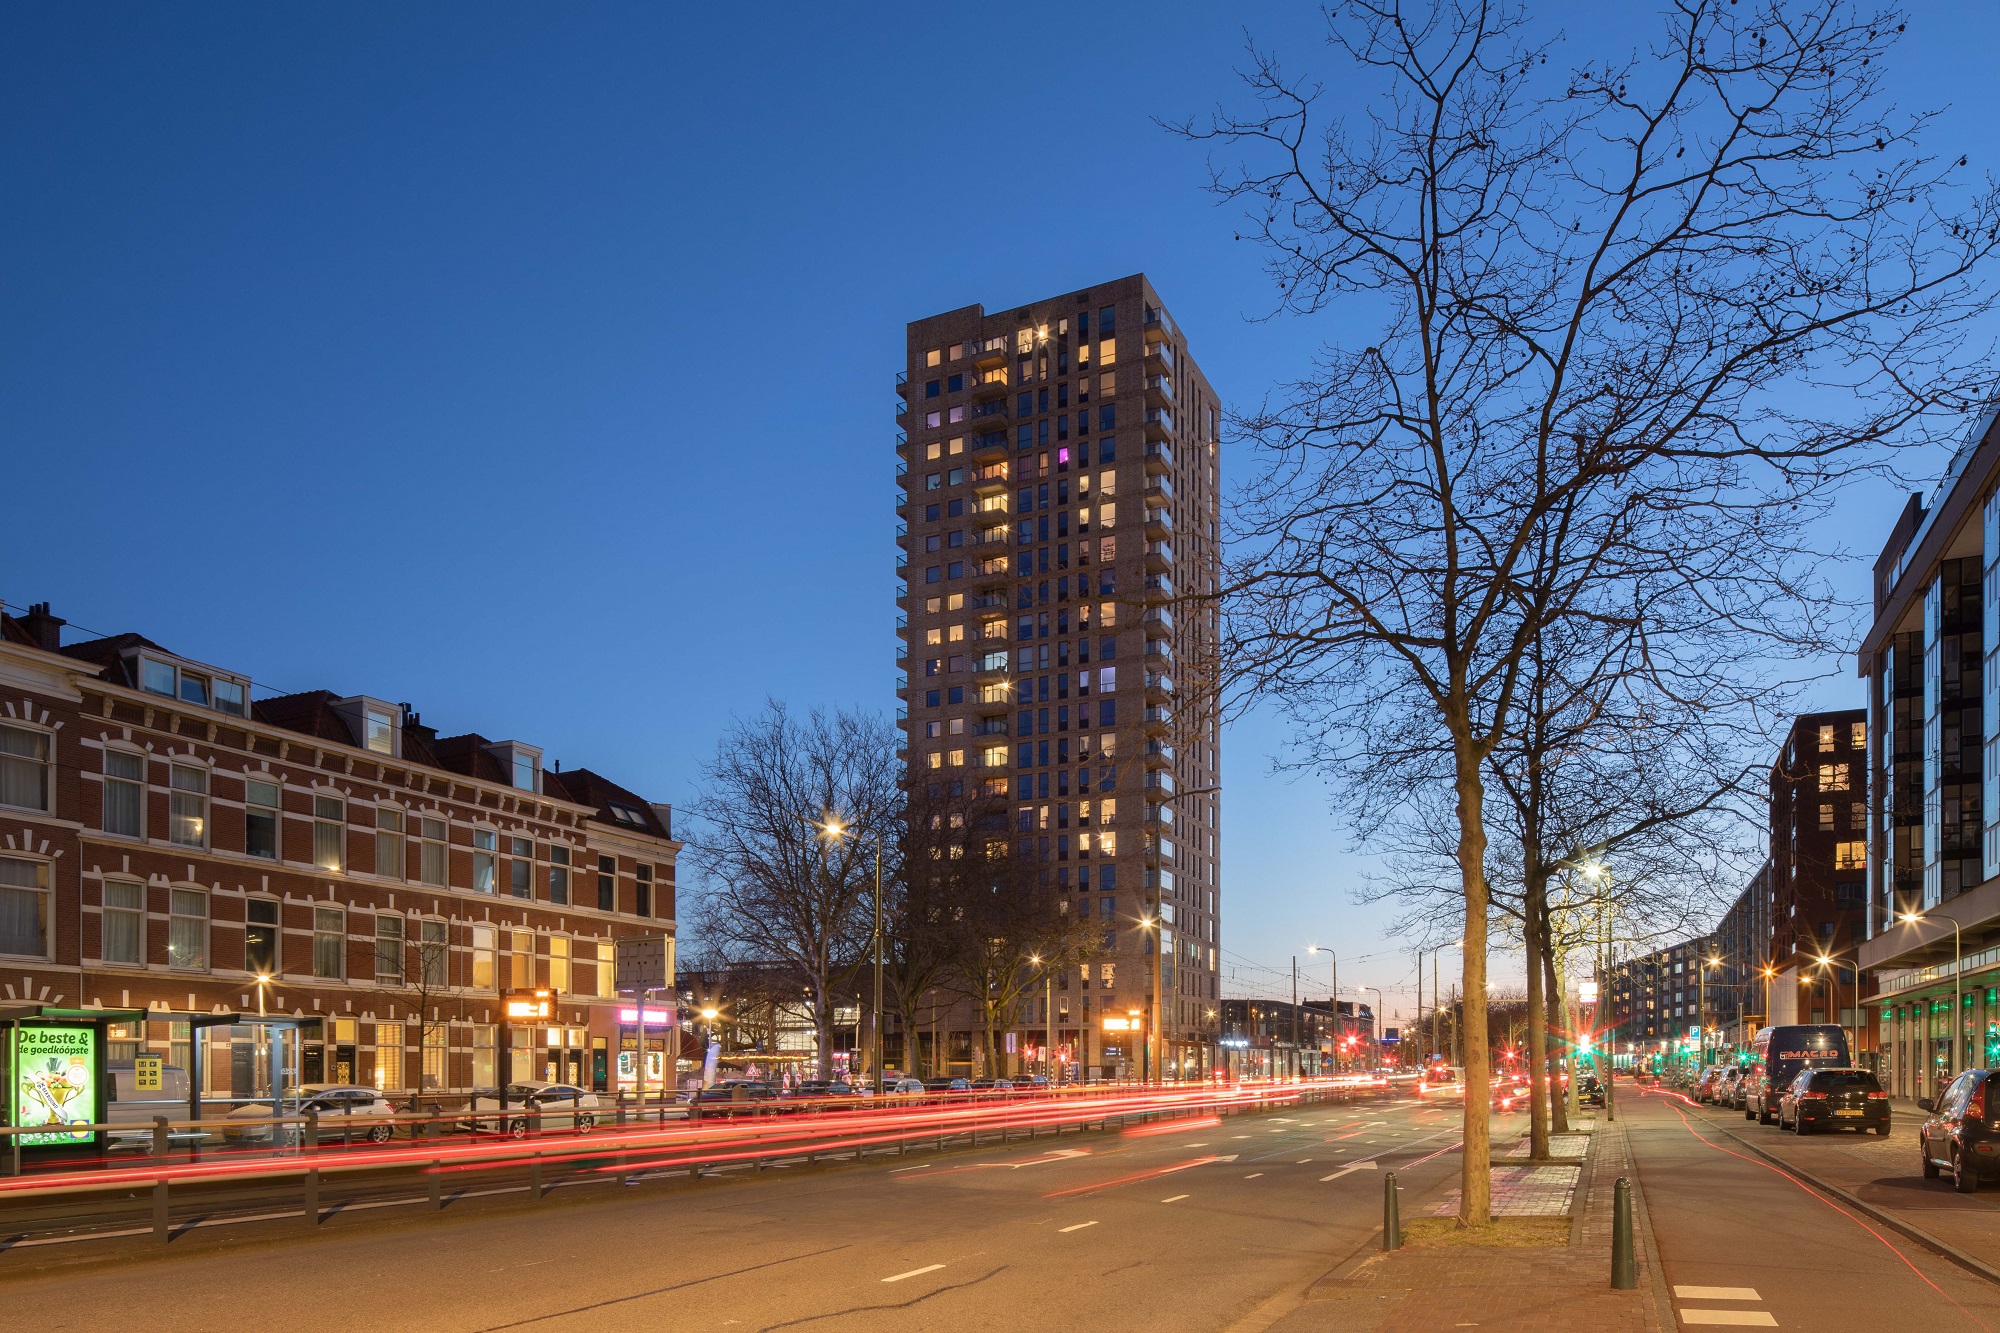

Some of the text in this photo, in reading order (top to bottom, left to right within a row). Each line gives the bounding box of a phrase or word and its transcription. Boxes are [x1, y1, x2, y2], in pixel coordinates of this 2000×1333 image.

[1692, 1028, 1698, 1036] P
[19, 1030, 88, 1046] De beste &
[30, 1046, 88, 1055] goedkóópste
